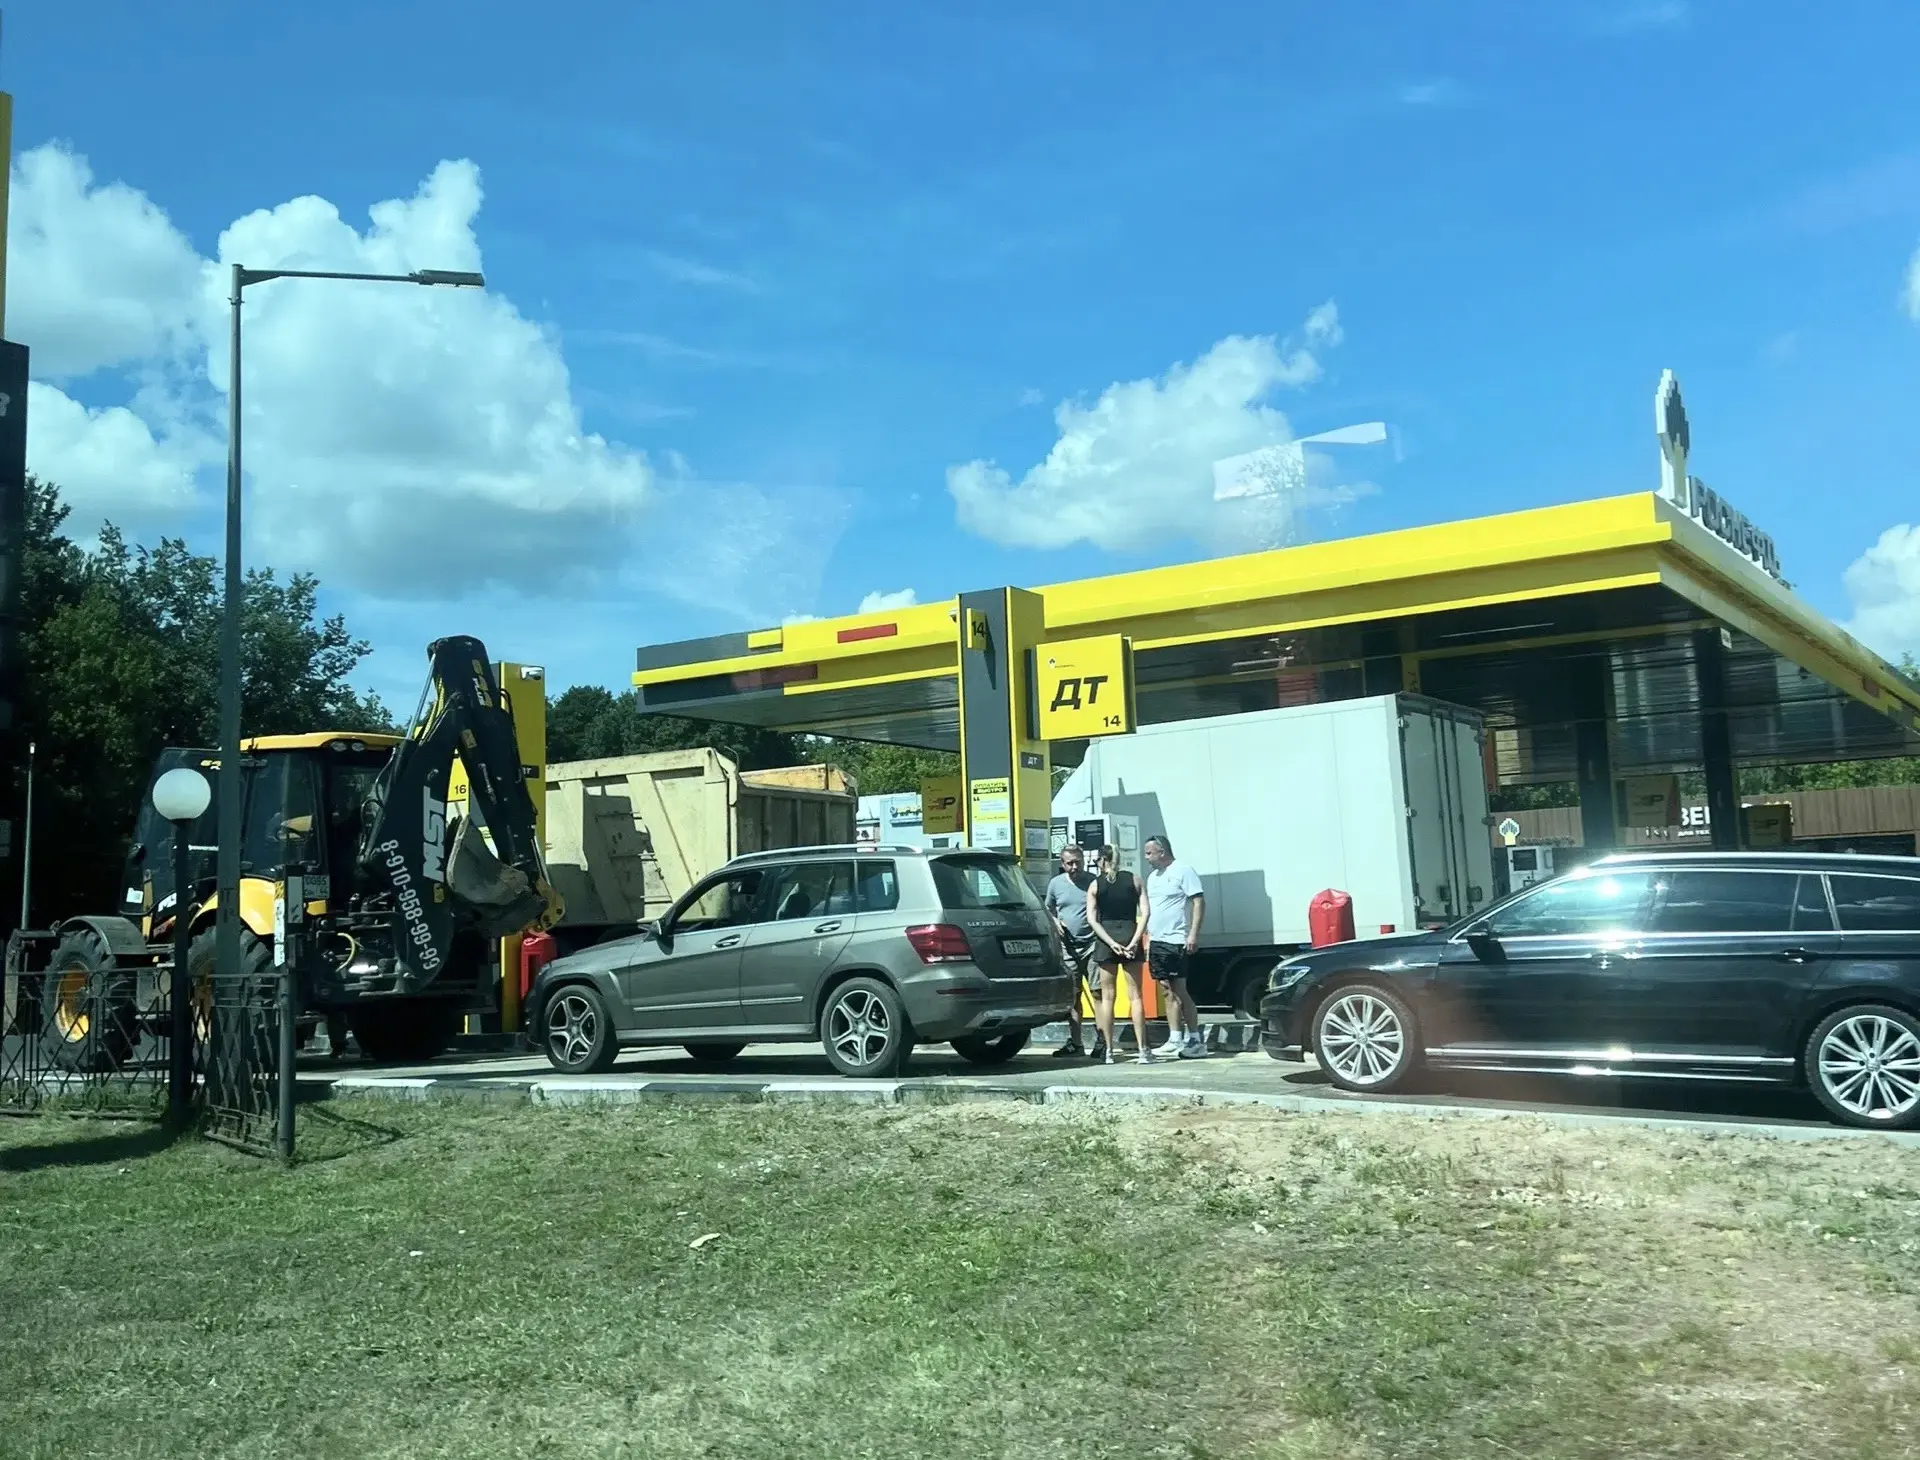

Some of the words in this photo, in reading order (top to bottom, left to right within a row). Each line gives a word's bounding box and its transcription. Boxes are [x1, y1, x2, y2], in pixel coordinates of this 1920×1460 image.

[972, 621, 985, 638] 14
[1050, 675, 1108, 712] ДТ
[1103, 715, 1121, 728] 14
[455, 785, 467, 795] 16
[423, 785, 445, 882] MST
[381, 839, 440, 970] 8-910-958-99-99
